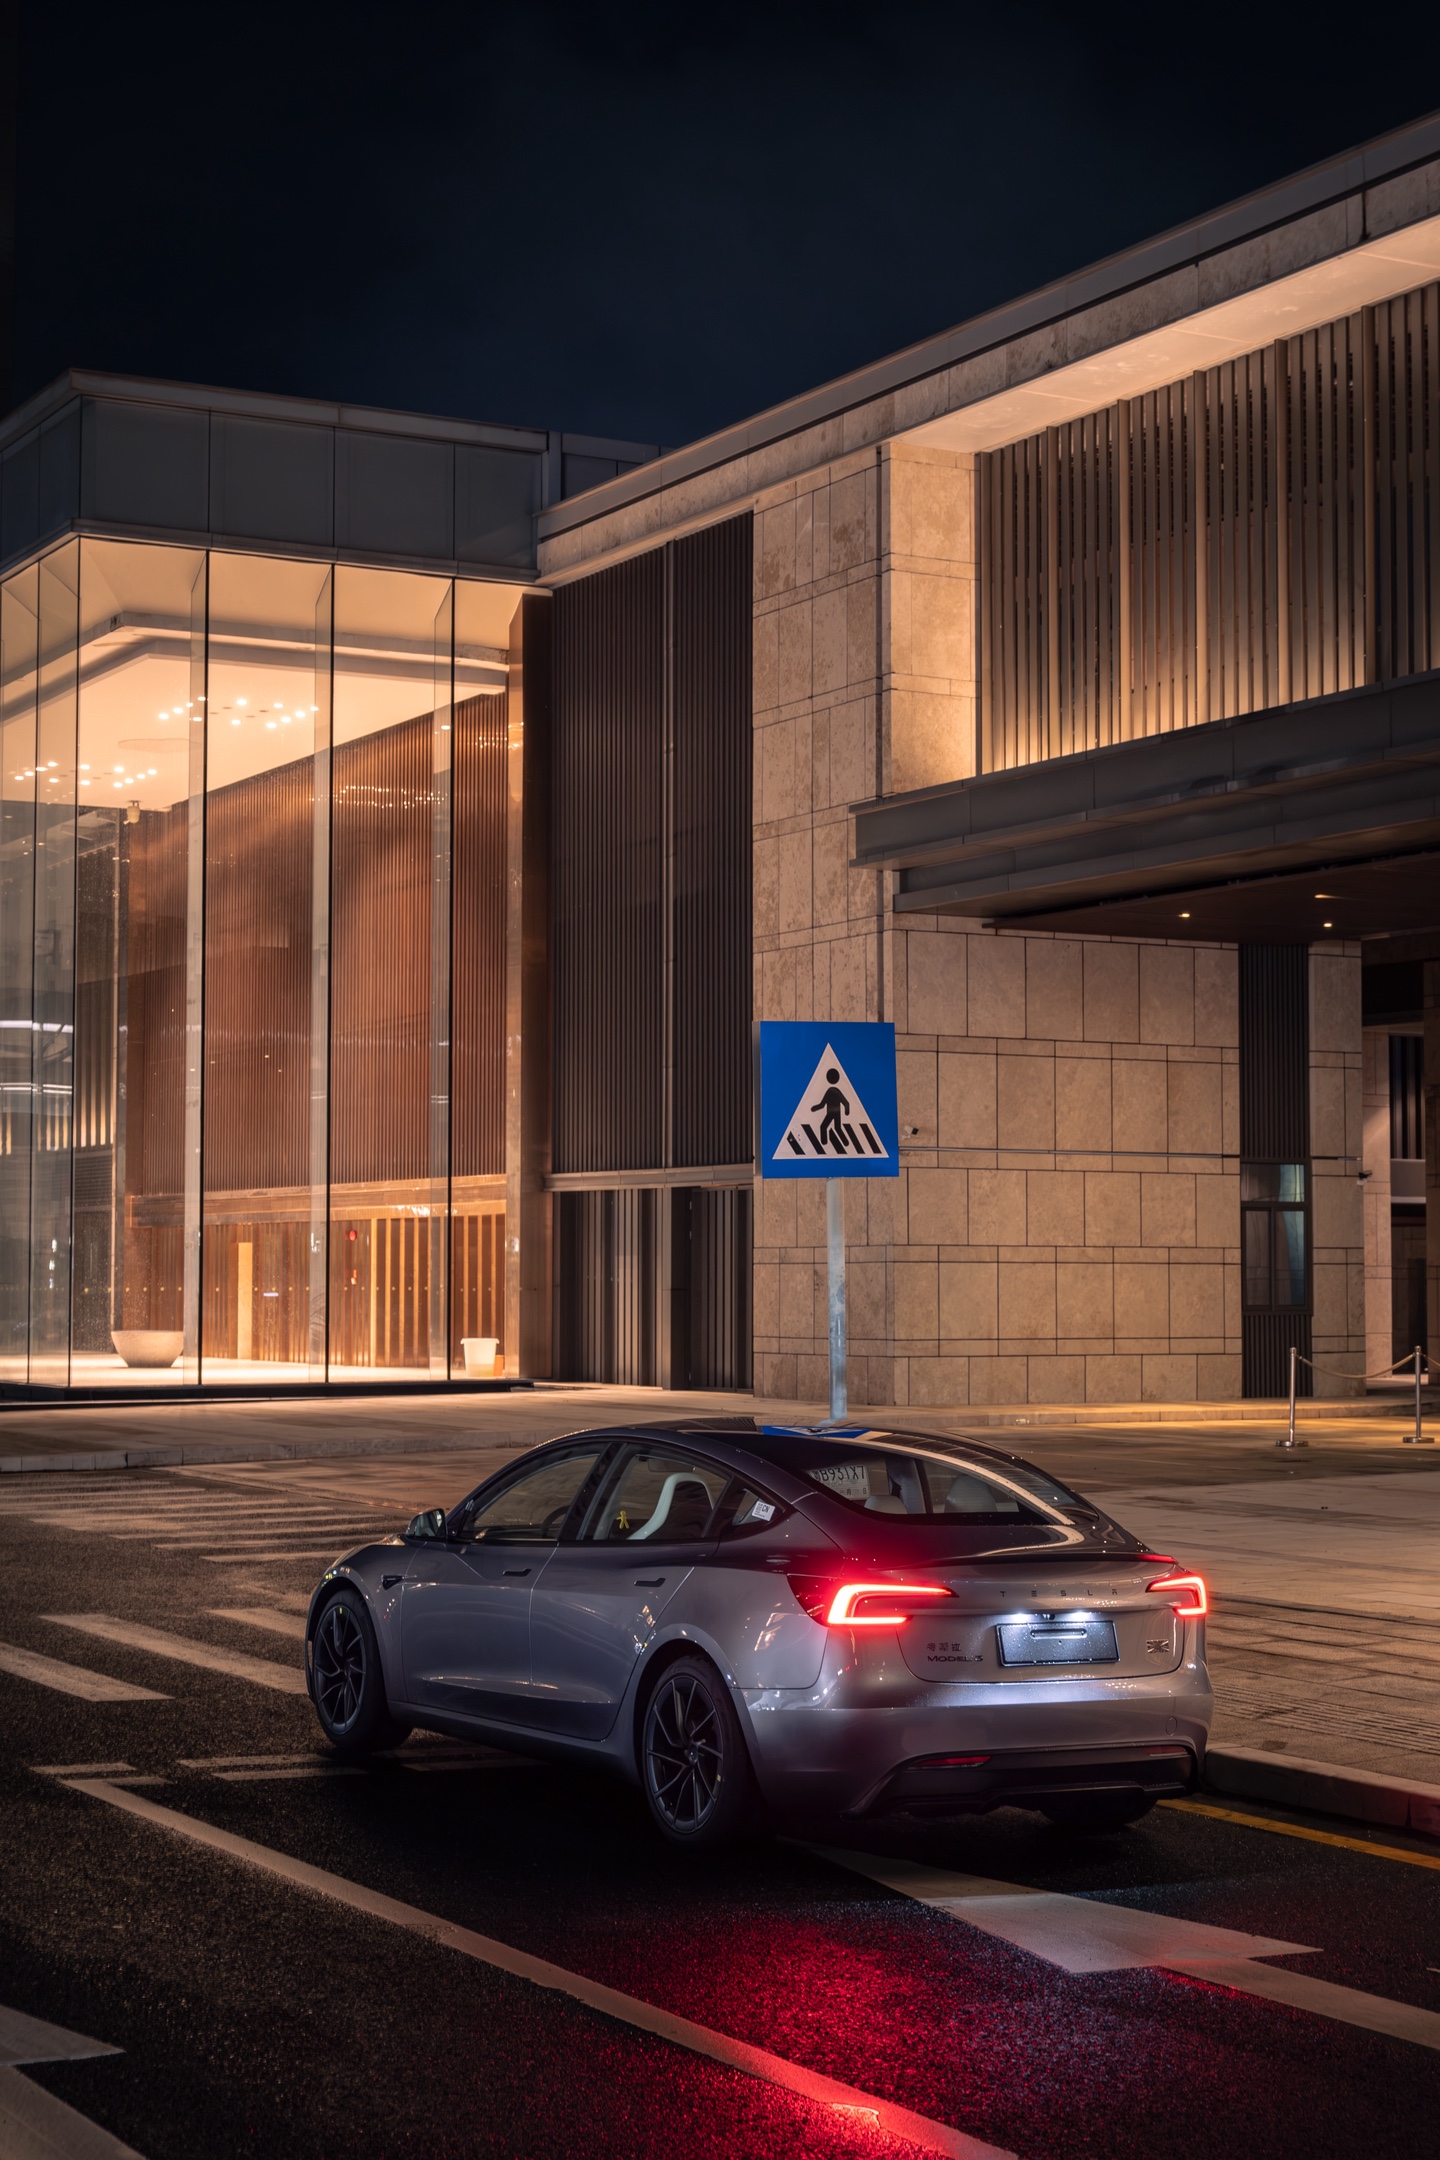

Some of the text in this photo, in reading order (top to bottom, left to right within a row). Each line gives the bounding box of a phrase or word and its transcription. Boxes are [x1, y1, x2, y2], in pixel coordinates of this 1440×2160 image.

[1000, 1588, 1117, 1597] TESLA
[926, 1642, 962, 1652] 特斯拉
[926, 1654, 984, 1663] MODEL 3
